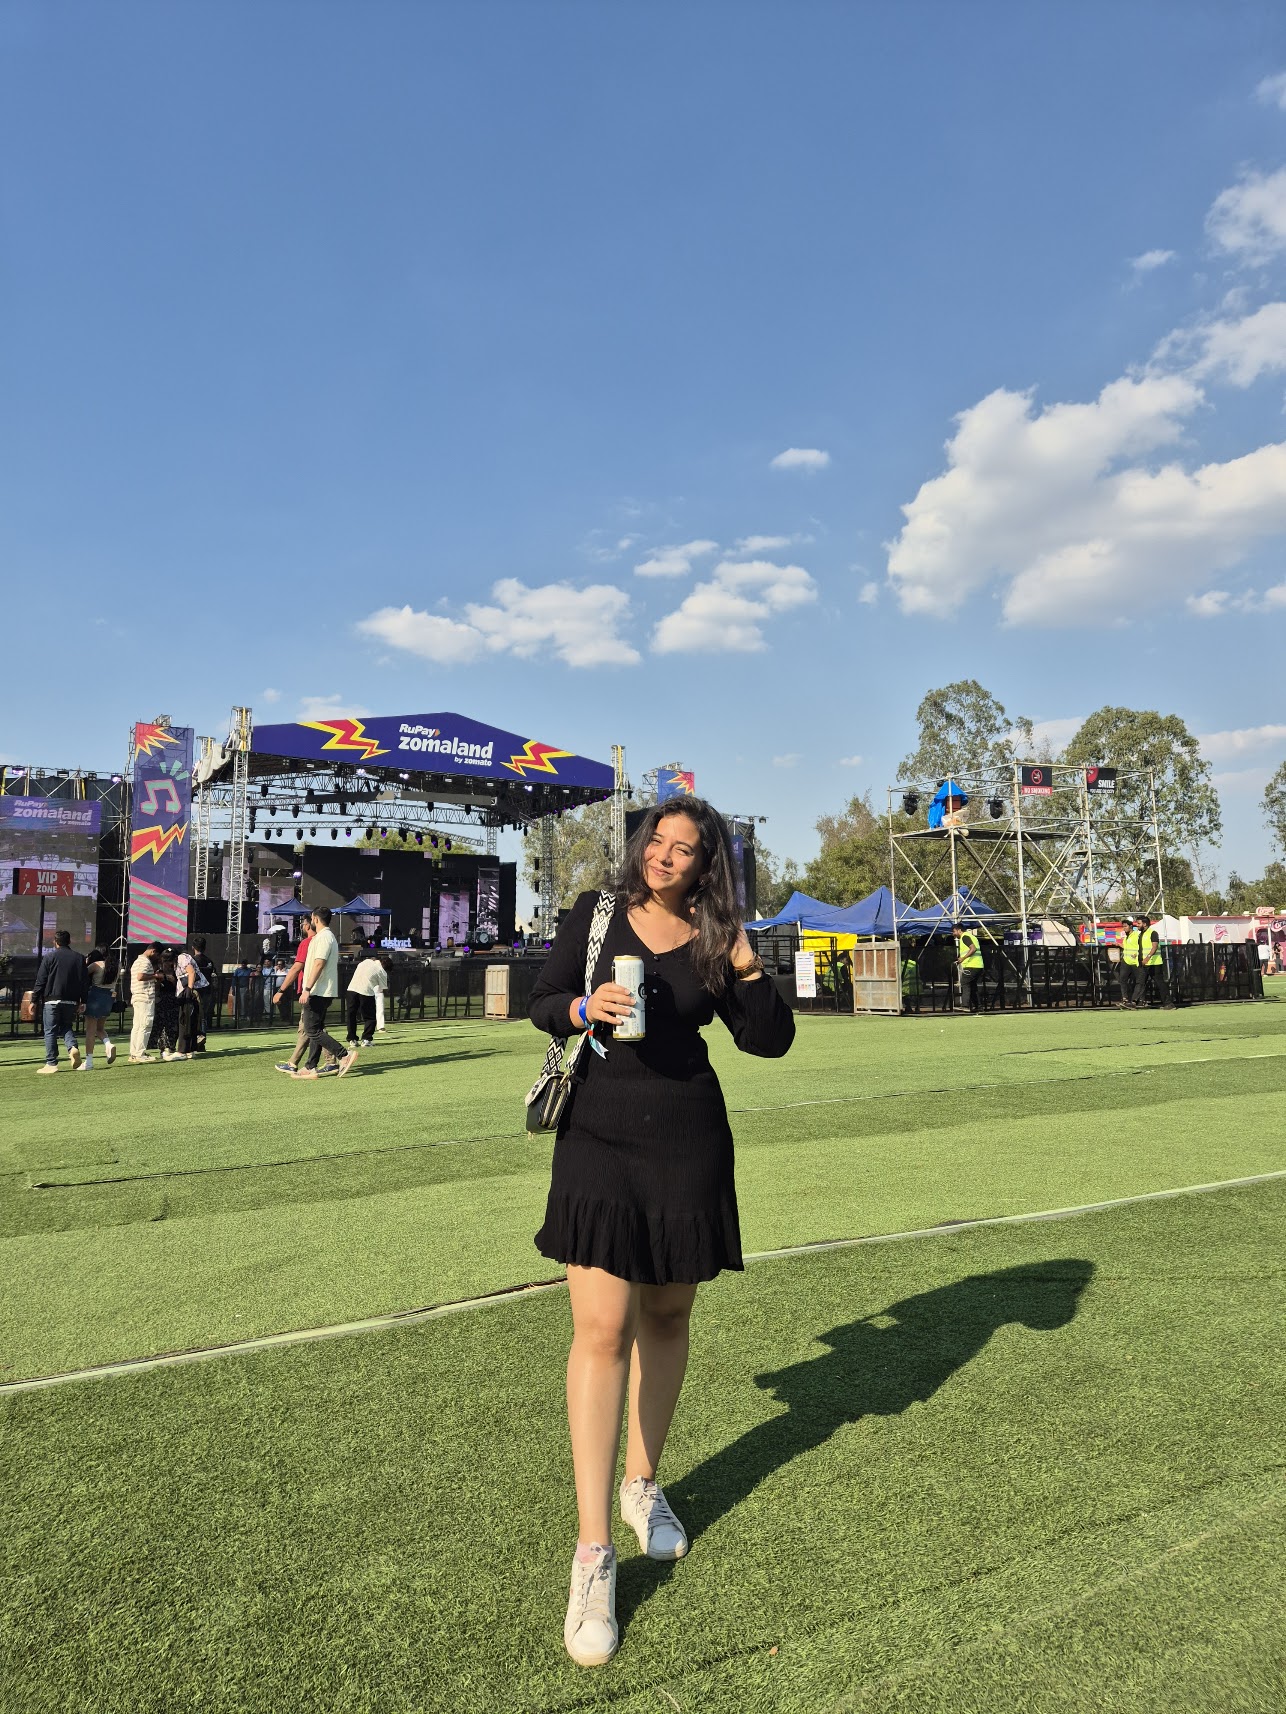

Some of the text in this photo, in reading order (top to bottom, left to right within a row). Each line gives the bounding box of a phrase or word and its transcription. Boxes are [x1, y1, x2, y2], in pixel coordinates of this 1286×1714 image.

[399, 723, 436, 738] RuPay
[398, 736, 494, 759] zomaland
[454, 756, 492, 766] by zomato
[1098, 779, 1115, 788] SMILE
[14, 800, 45, 809] RuPay
[13, 807, 93, 821] zomaland
[37, 871, 58, 884] VIP
[36, 885, 58, 893] ZONE
[381, 937, 411, 947] district
